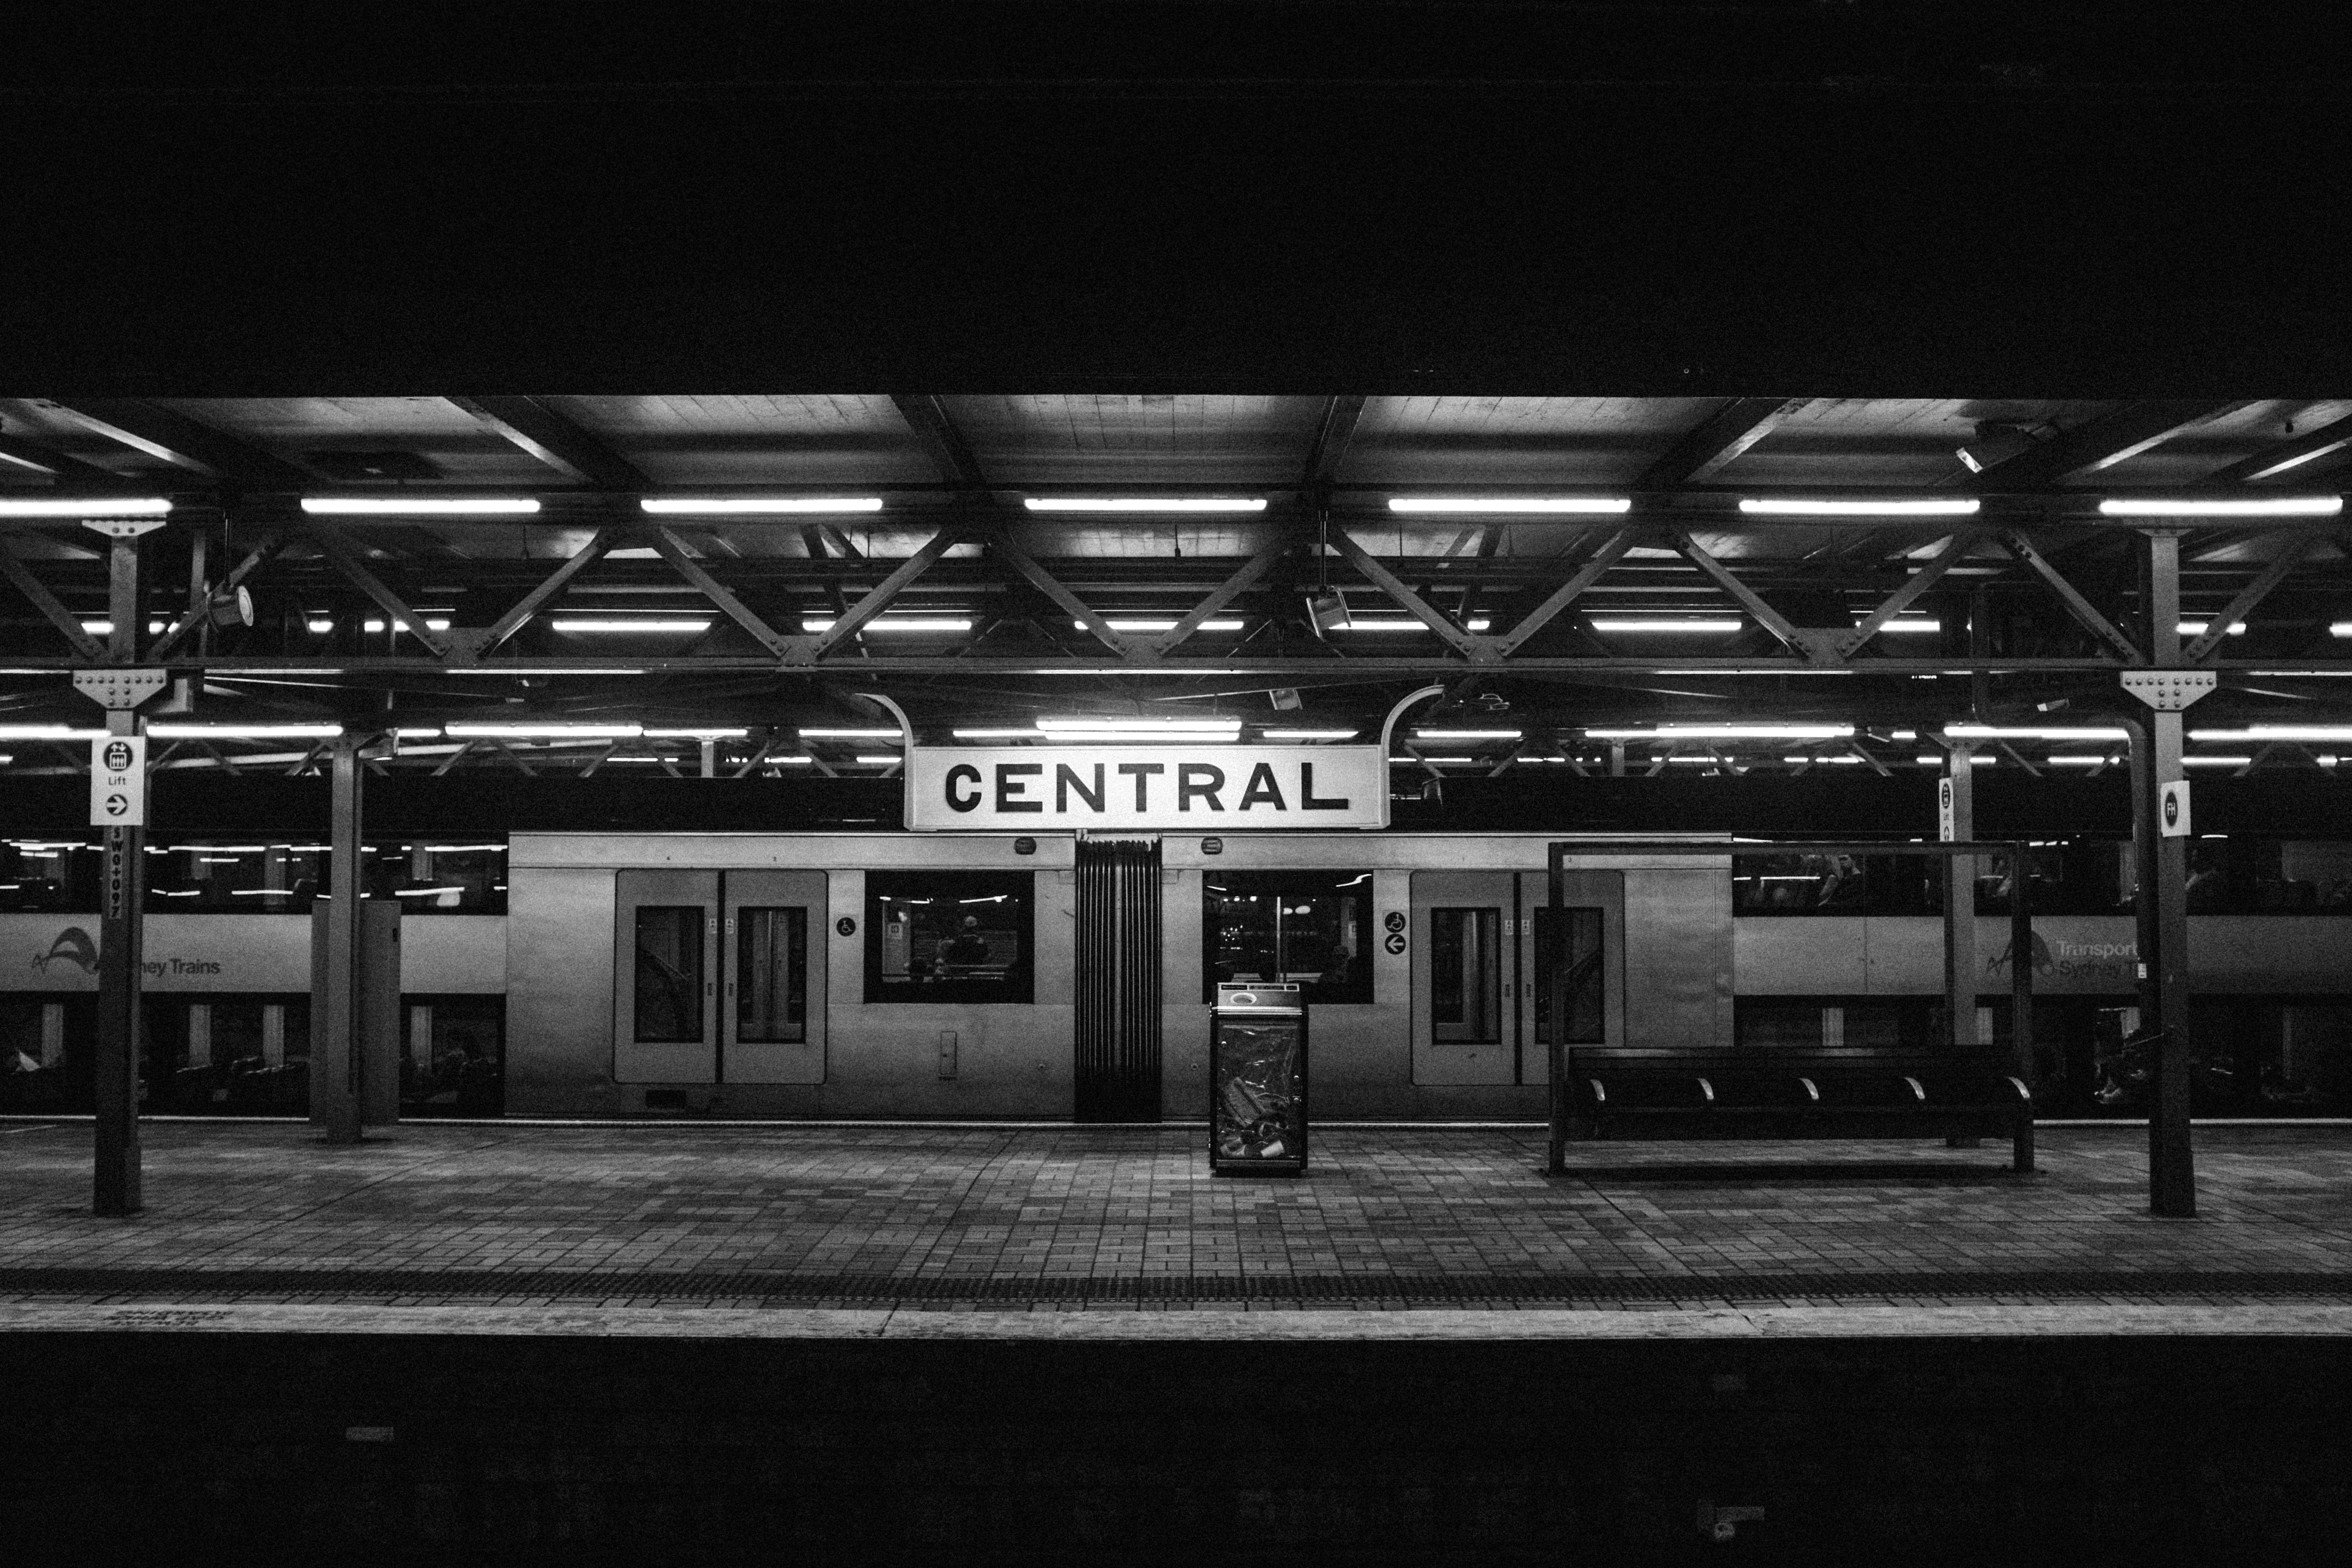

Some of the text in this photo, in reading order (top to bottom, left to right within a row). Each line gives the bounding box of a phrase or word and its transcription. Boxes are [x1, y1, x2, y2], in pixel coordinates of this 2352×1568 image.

[108, 776, 126, 785] Lift
[945, 762, 1350, 813] CENTRAL
[2167, 802, 2176, 817] FH
[2056, 940, 2138, 959] Transport
[141, 958, 221, 977] ney Trains
